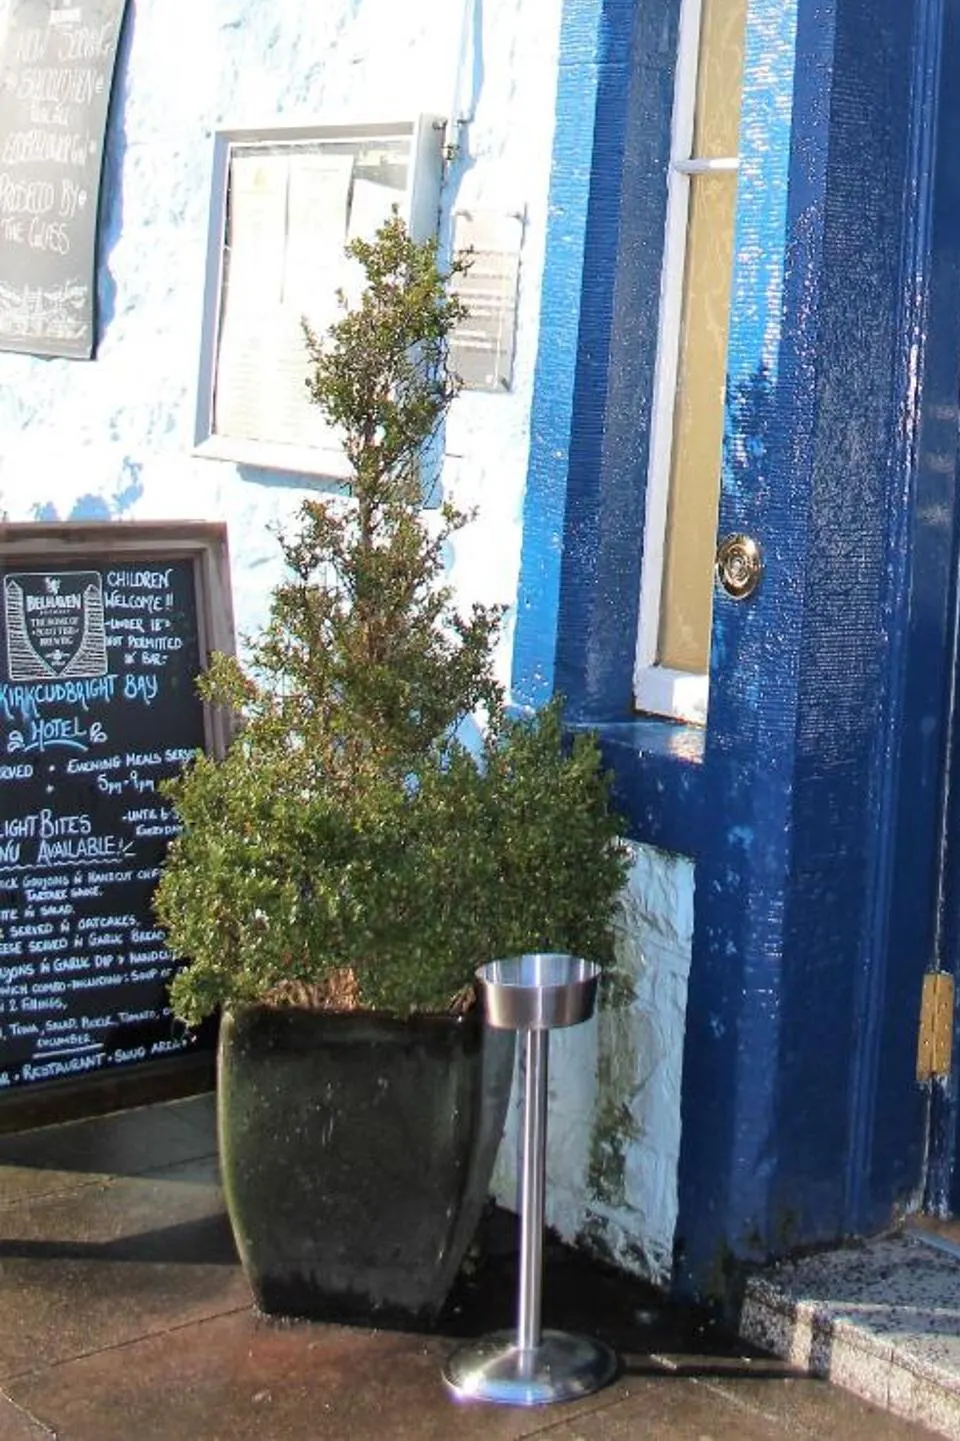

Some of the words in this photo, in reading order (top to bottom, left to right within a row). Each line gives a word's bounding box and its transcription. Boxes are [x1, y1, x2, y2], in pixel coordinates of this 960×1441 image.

[106, 569, 174, 589] CHILDREN
[26, 593, 82, 612] BELHAVEN
[0, 674, 119, 720] KIRKCUDBRIGHT
[125, 673, 158, 705] BAY
[32, 716, 87, 752] HOTEL
[126, 753, 162, 767] MEALS
[40, 809, 92, 839] BITES
[22, 1052, 106, 1081] RESTAURANT
